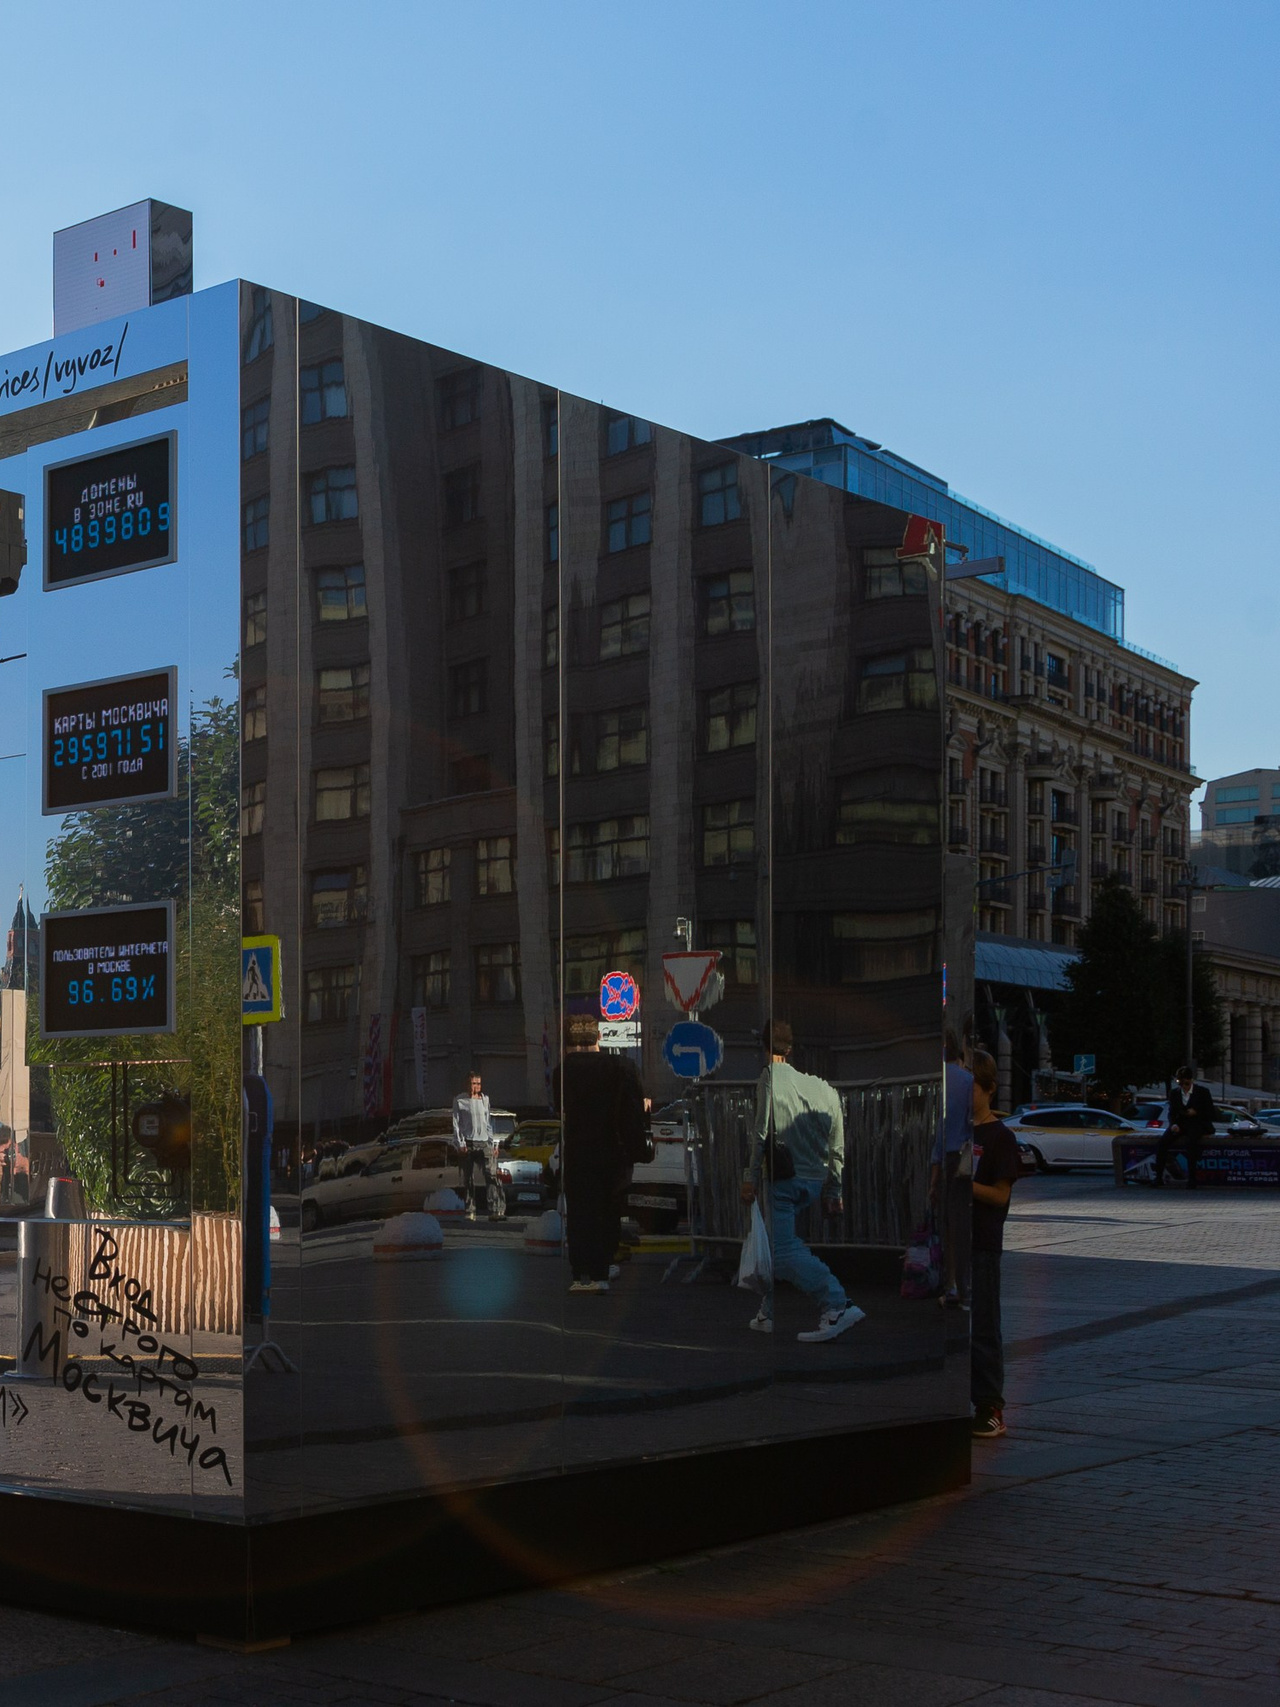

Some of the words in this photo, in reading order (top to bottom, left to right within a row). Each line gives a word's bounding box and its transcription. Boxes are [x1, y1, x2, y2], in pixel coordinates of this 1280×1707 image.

[81, 473, 137, 503] ДОМЕНЫ
[74, 507, 81, 523] В
[89, 491, 144, 519] ЗОНЕ.RU
[54, 502, 169, 555] 4899809
[54, 712, 96, 735] КАРТЫ
[101, 698, 168, 727] МОСКВИЧА
[53, 722, 163, 767] 29597151
[82, 766, 87, 780] С
[91, 763, 113, 778] 2001
[117, 757, 143, 774] ГОДА
[53, 946, 116, 962] ПОЛЬЗОВАТЕЛИ
[118, 941, 168, 957] ИНТЕРНЕТА
[88, 962, 94, 974] В
[97, 959, 131, 974] МОСКВЕ
[68, 974, 155, 1005] 96.69%
[89, 1227, 158, 1323] Вход
[100, 1338, 217, 1434] картам
[22, 1321, 233, 1487] Москвича
